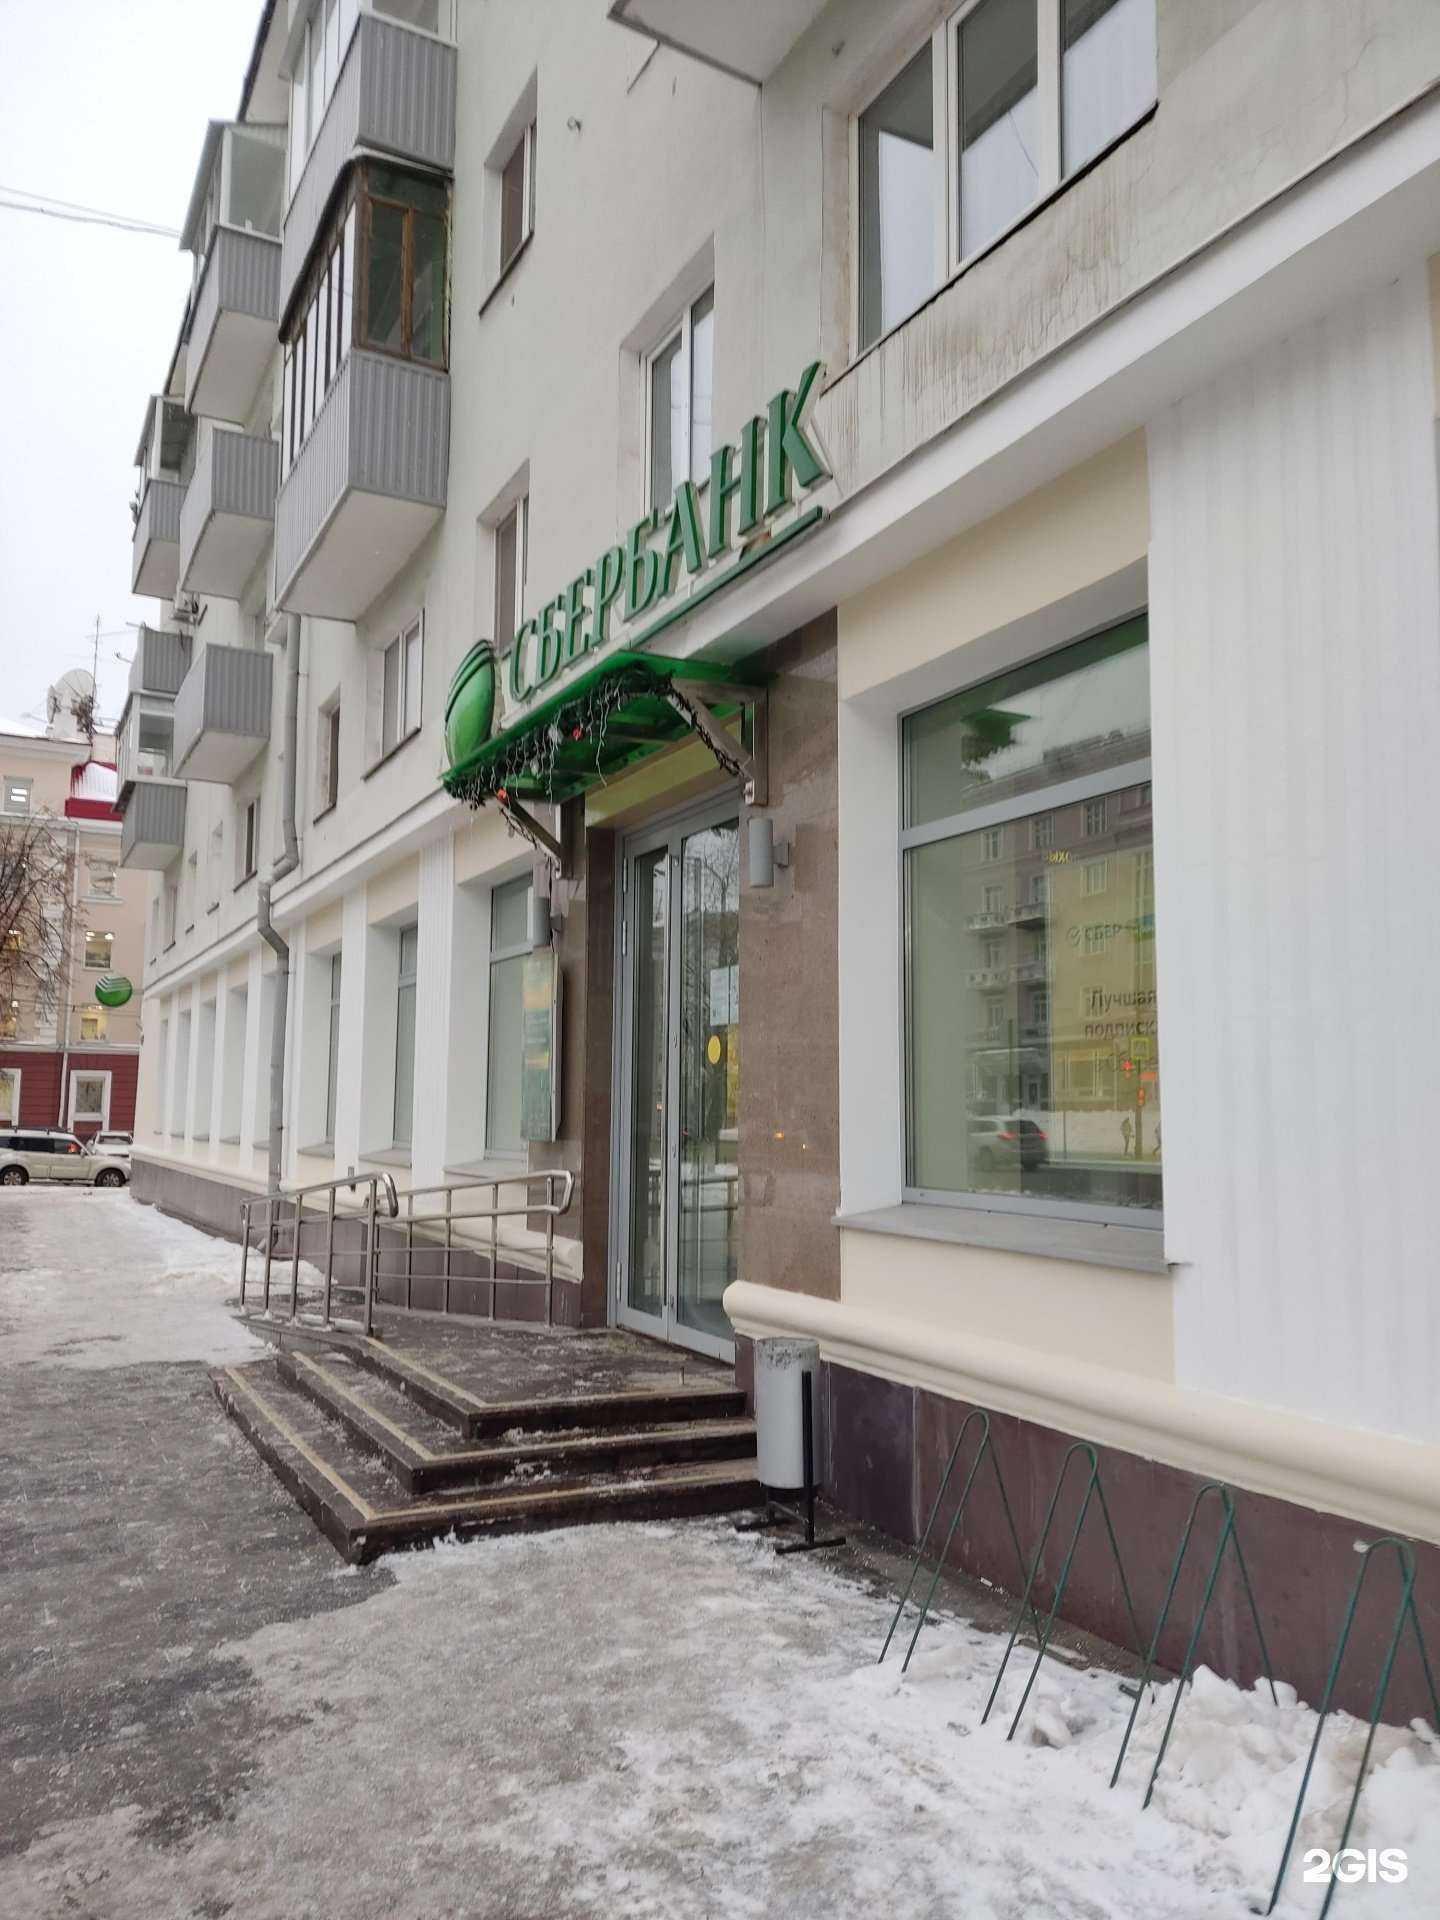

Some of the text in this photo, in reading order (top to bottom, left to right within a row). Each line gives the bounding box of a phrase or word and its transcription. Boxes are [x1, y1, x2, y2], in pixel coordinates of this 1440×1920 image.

[509, 361, 829, 702] СБЕРБАНК
[1090, 988, 1157, 1013] Лучшая
[1084, 1020, 1157, 1041] подписк
